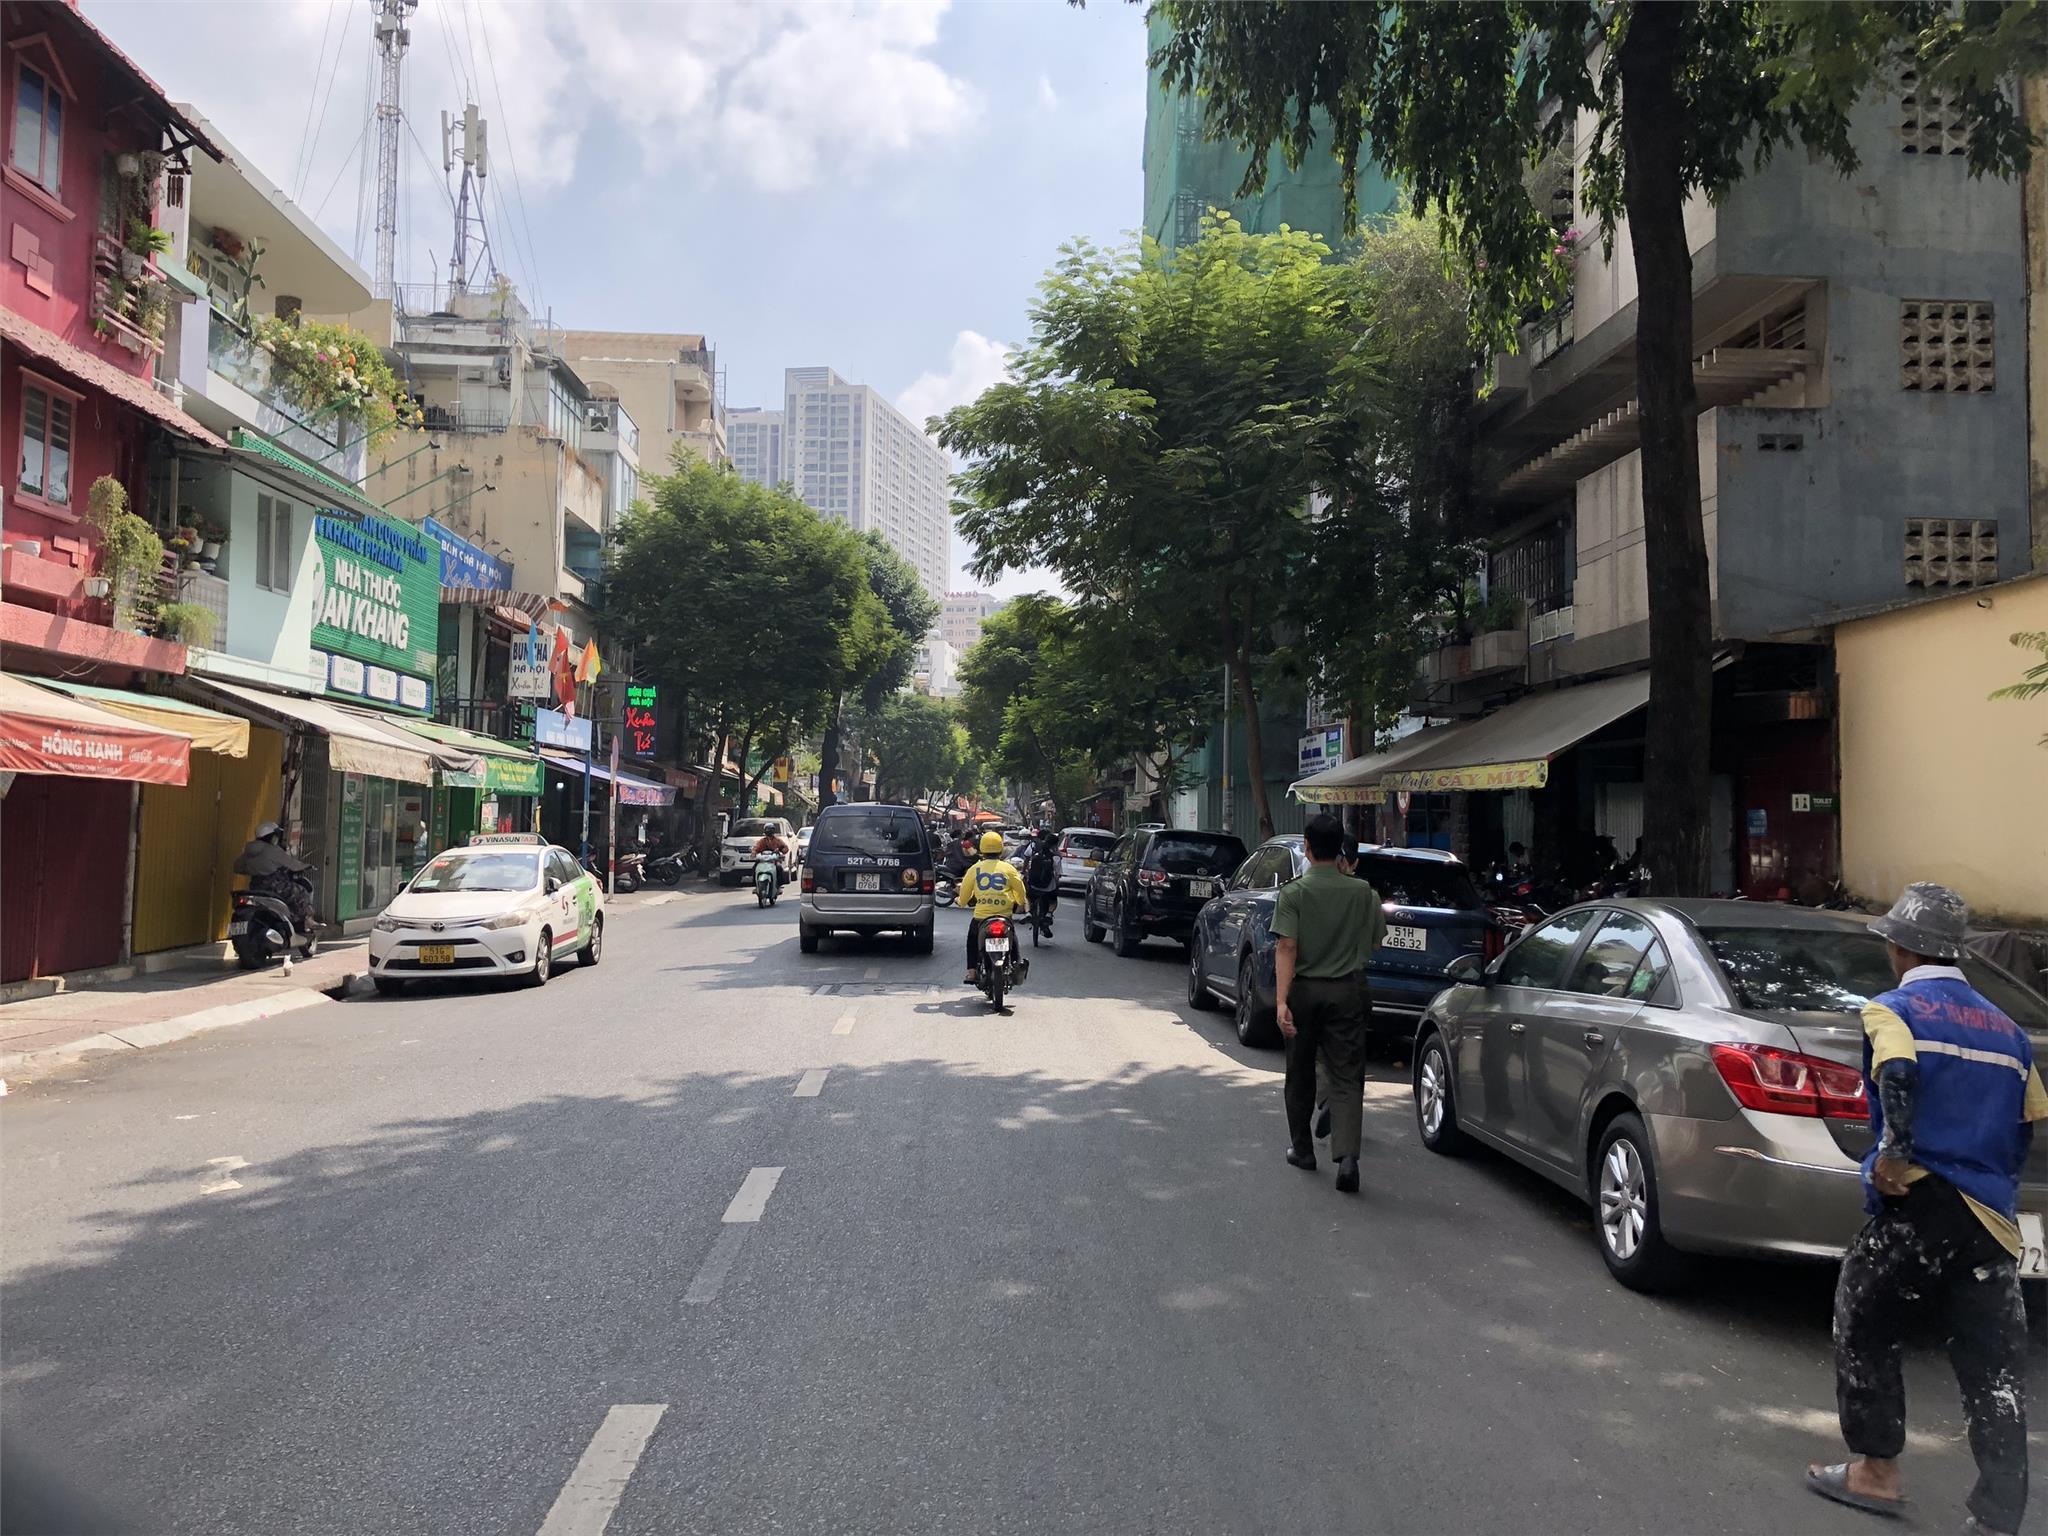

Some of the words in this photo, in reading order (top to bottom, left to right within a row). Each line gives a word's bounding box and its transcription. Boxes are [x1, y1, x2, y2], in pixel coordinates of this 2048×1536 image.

[335, 557, 361, 593] NHÀ
[363, 569, 401, 609] THUỐC
[322, 587, 352, 630] AN
[351, 596, 409, 650] KHANG
[86, 740, 123, 763] HẠNH
[847, 857, 864, 865] 52T
[976, 867, 1006, 891] be
[1387, 937, 1421, 950] 486.32
[1394, 927, 1414, 938] 51H
